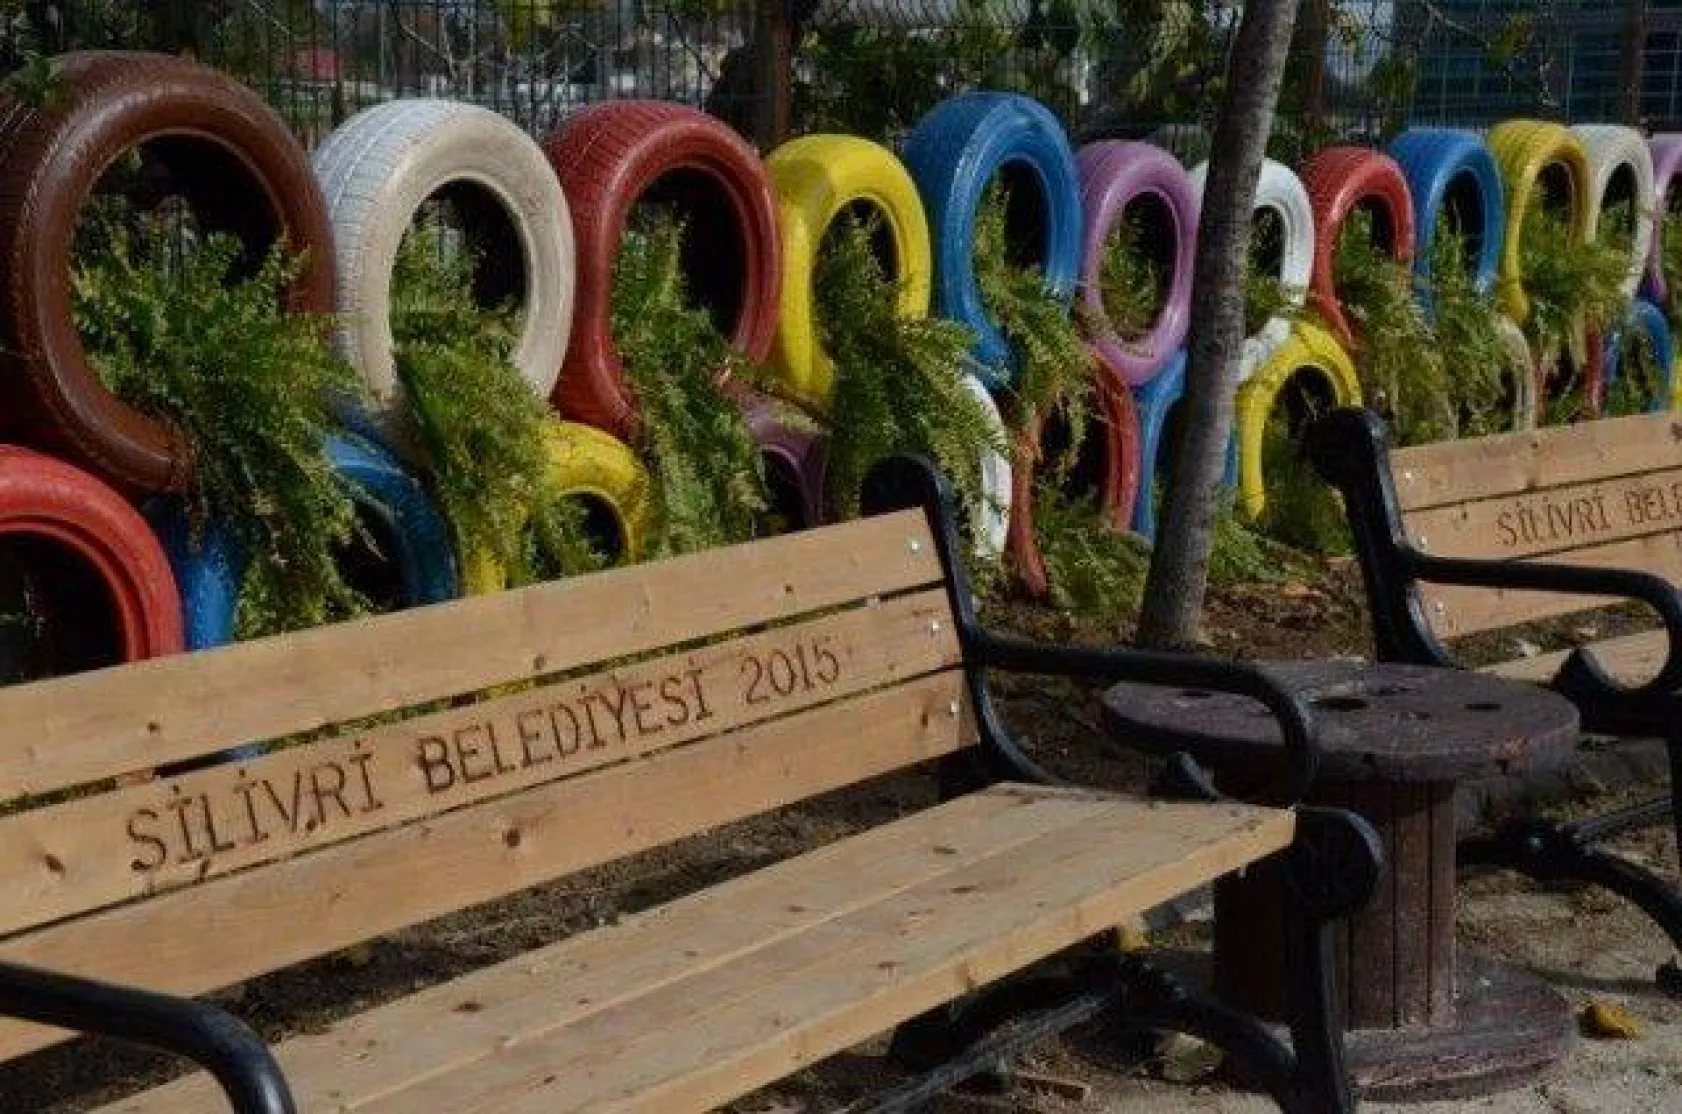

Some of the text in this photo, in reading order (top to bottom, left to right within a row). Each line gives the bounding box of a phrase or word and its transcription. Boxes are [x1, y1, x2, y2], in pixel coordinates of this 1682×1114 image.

[126, 634, 840, 871] SİLİVRİ BELEDİYESİ 2015
